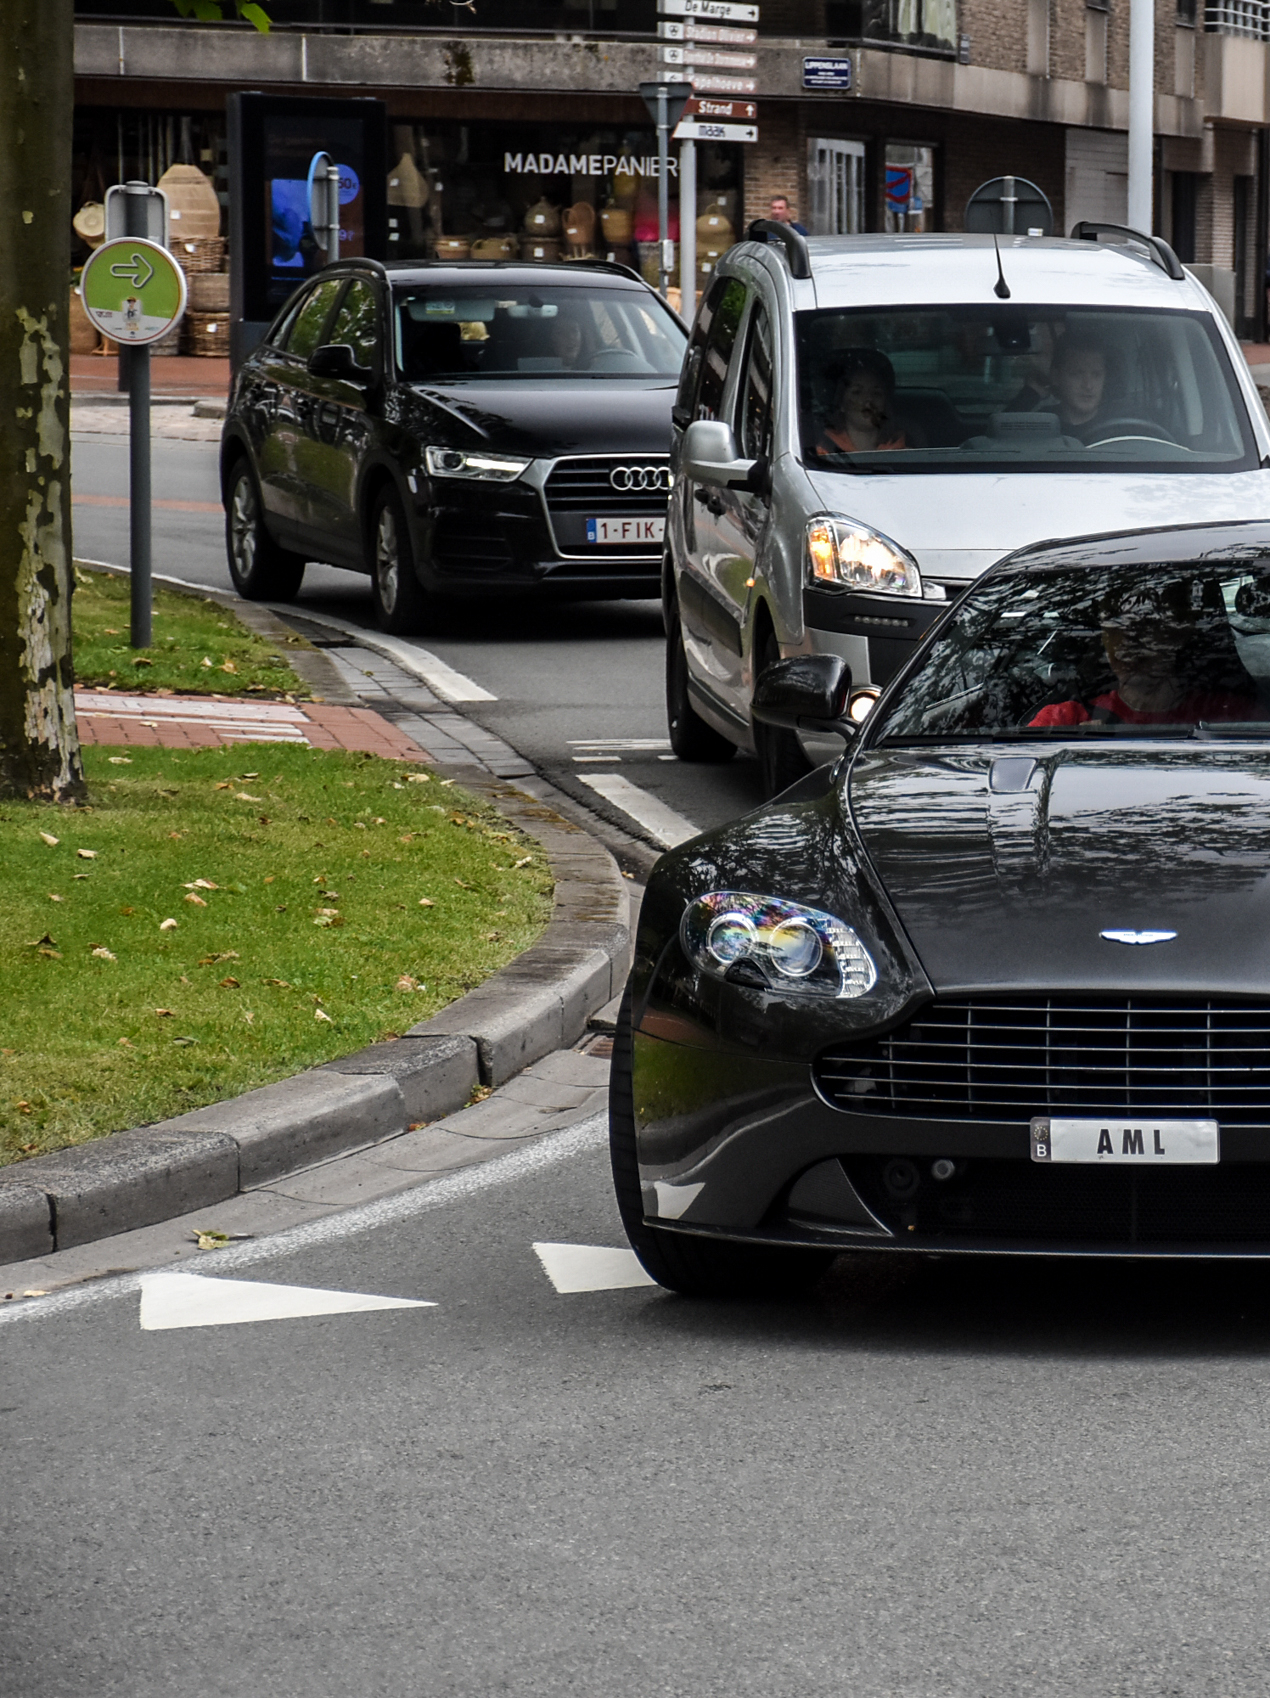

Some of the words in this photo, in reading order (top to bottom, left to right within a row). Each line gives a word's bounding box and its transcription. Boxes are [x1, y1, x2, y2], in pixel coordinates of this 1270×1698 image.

[685, 0, 698, 12] De
[701, 2, 731, 18] Marge
[698, 101, 733, 115] Strand
[1036, 1144, 1047, 1157] B
